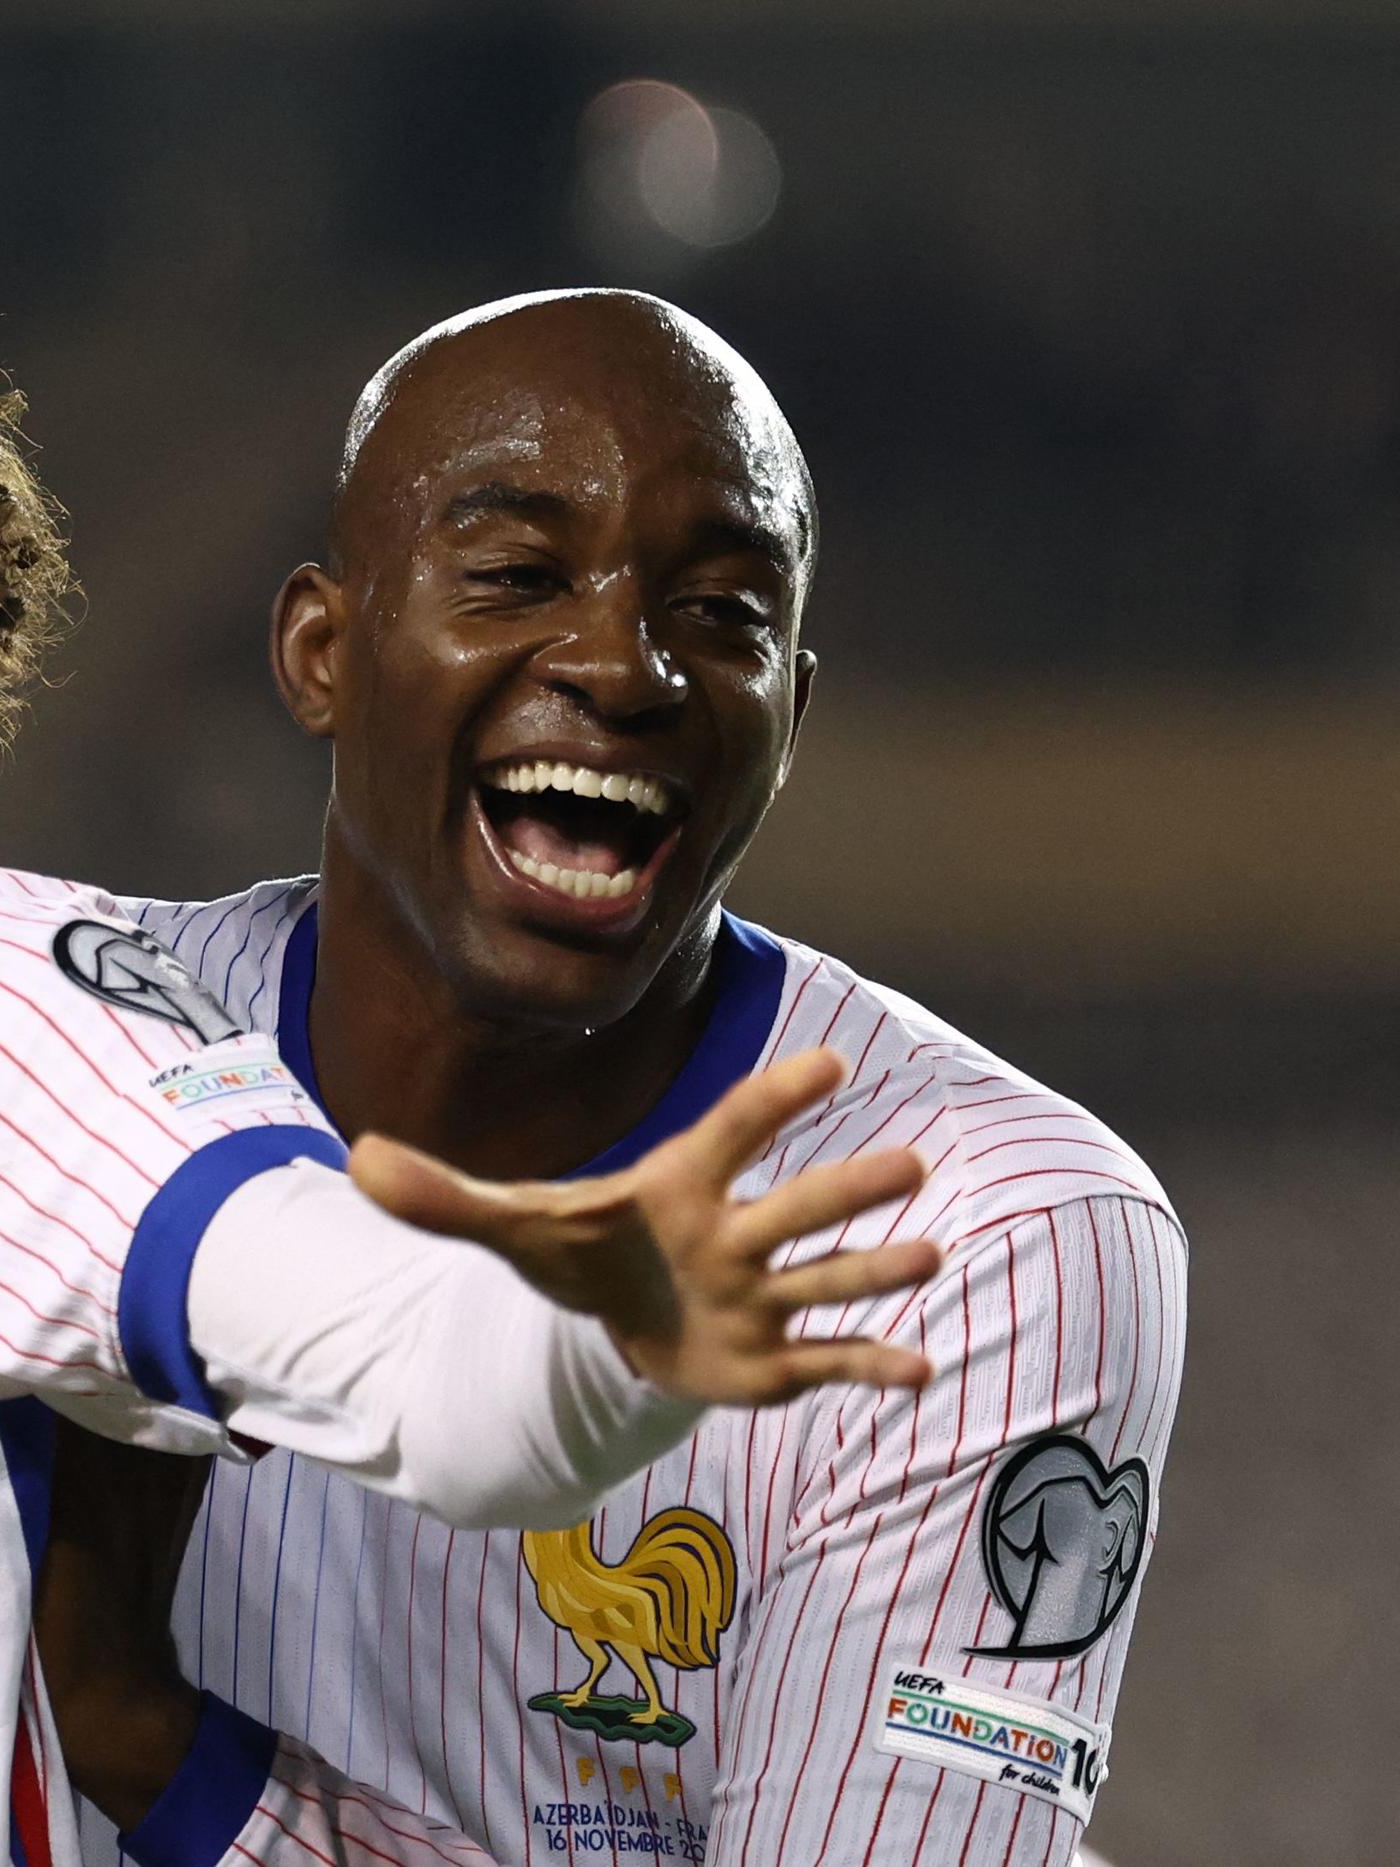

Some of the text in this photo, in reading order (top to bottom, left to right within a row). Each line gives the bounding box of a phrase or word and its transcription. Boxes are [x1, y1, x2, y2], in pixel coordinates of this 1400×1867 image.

[149, 1064, 193, 1087] UEFA
[894, 1671, 945, 1695] UEFA
[998, 1763, 1060, 1796] for children
[533, 1800, 659, 1830] AZERBAÏDJAN
[676, 1818, 710, 1841] FRA
[546, 1829, 567, 1851] 16
[575, 1829, 675, 1856] NOVEMBRE
